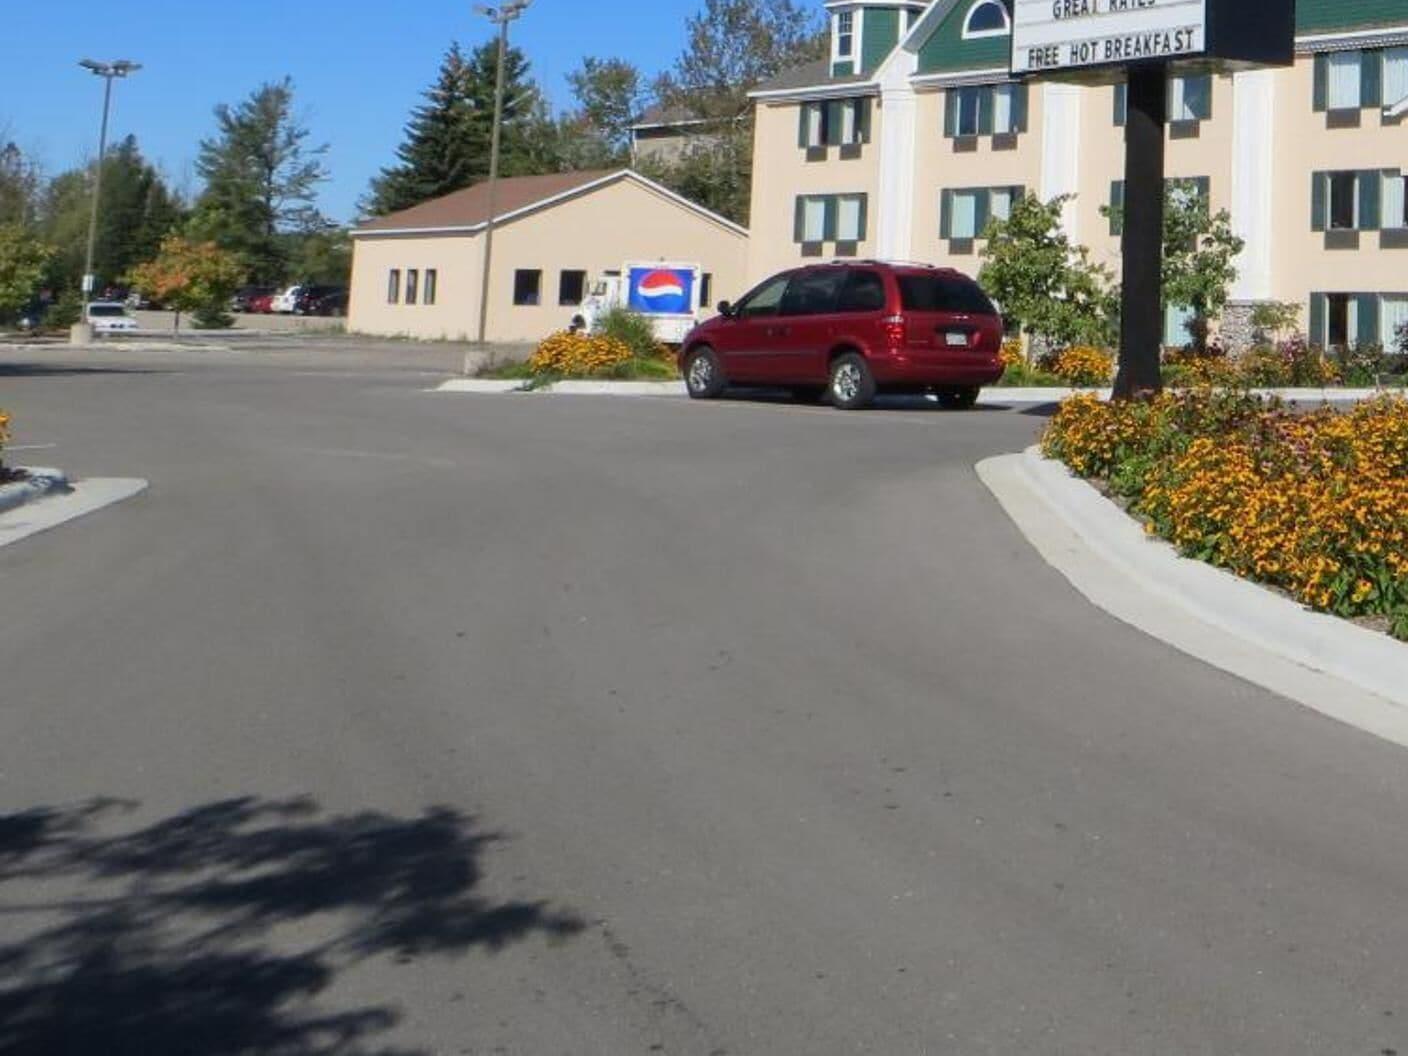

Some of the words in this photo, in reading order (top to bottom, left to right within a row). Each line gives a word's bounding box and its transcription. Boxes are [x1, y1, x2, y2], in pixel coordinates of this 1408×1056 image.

[1028, 47, 1060, 68] FREE
[1070, 41, 1098, 63] HOT
[1104, 29, 1194, 59] BREAKFAST
